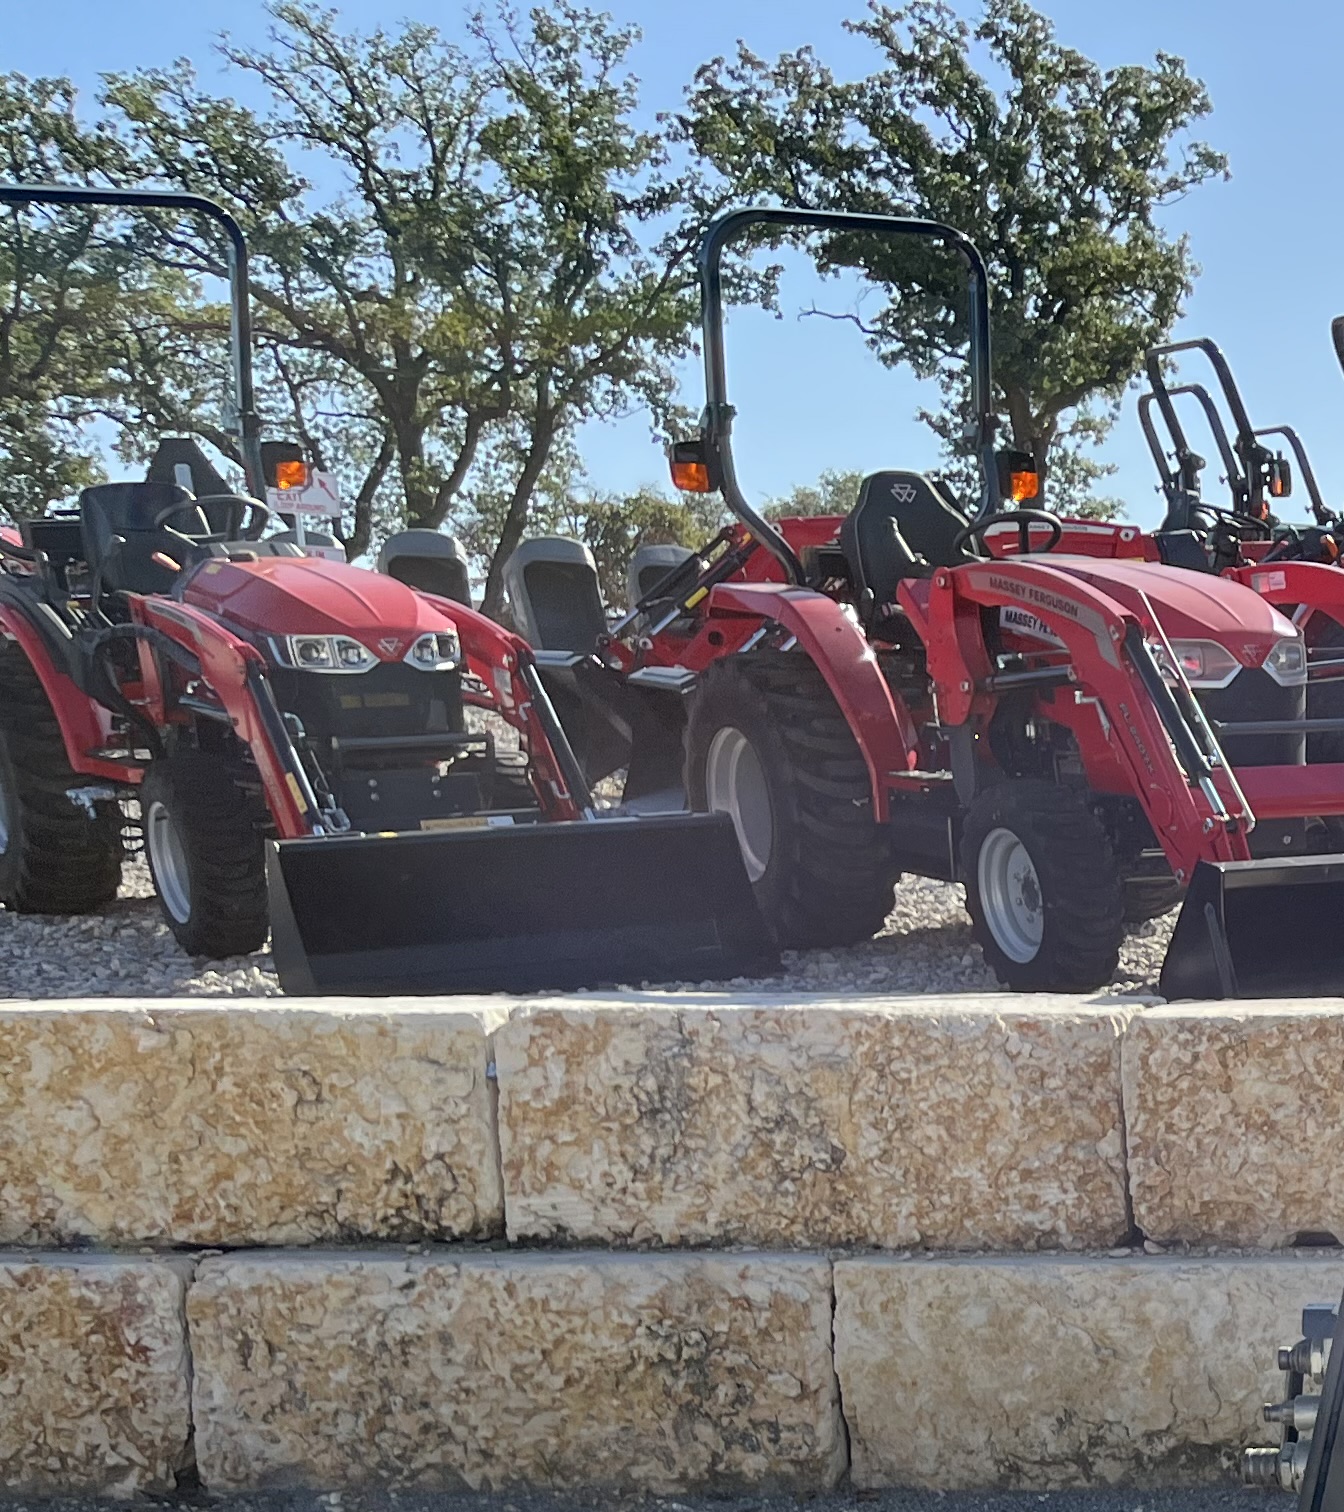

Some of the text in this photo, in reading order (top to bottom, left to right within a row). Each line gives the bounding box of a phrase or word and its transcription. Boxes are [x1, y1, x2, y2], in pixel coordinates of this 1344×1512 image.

[989, 576, 1079, 618] MASSEY FERGUSON
[1004, 609, 1039, 630] MASSEY
